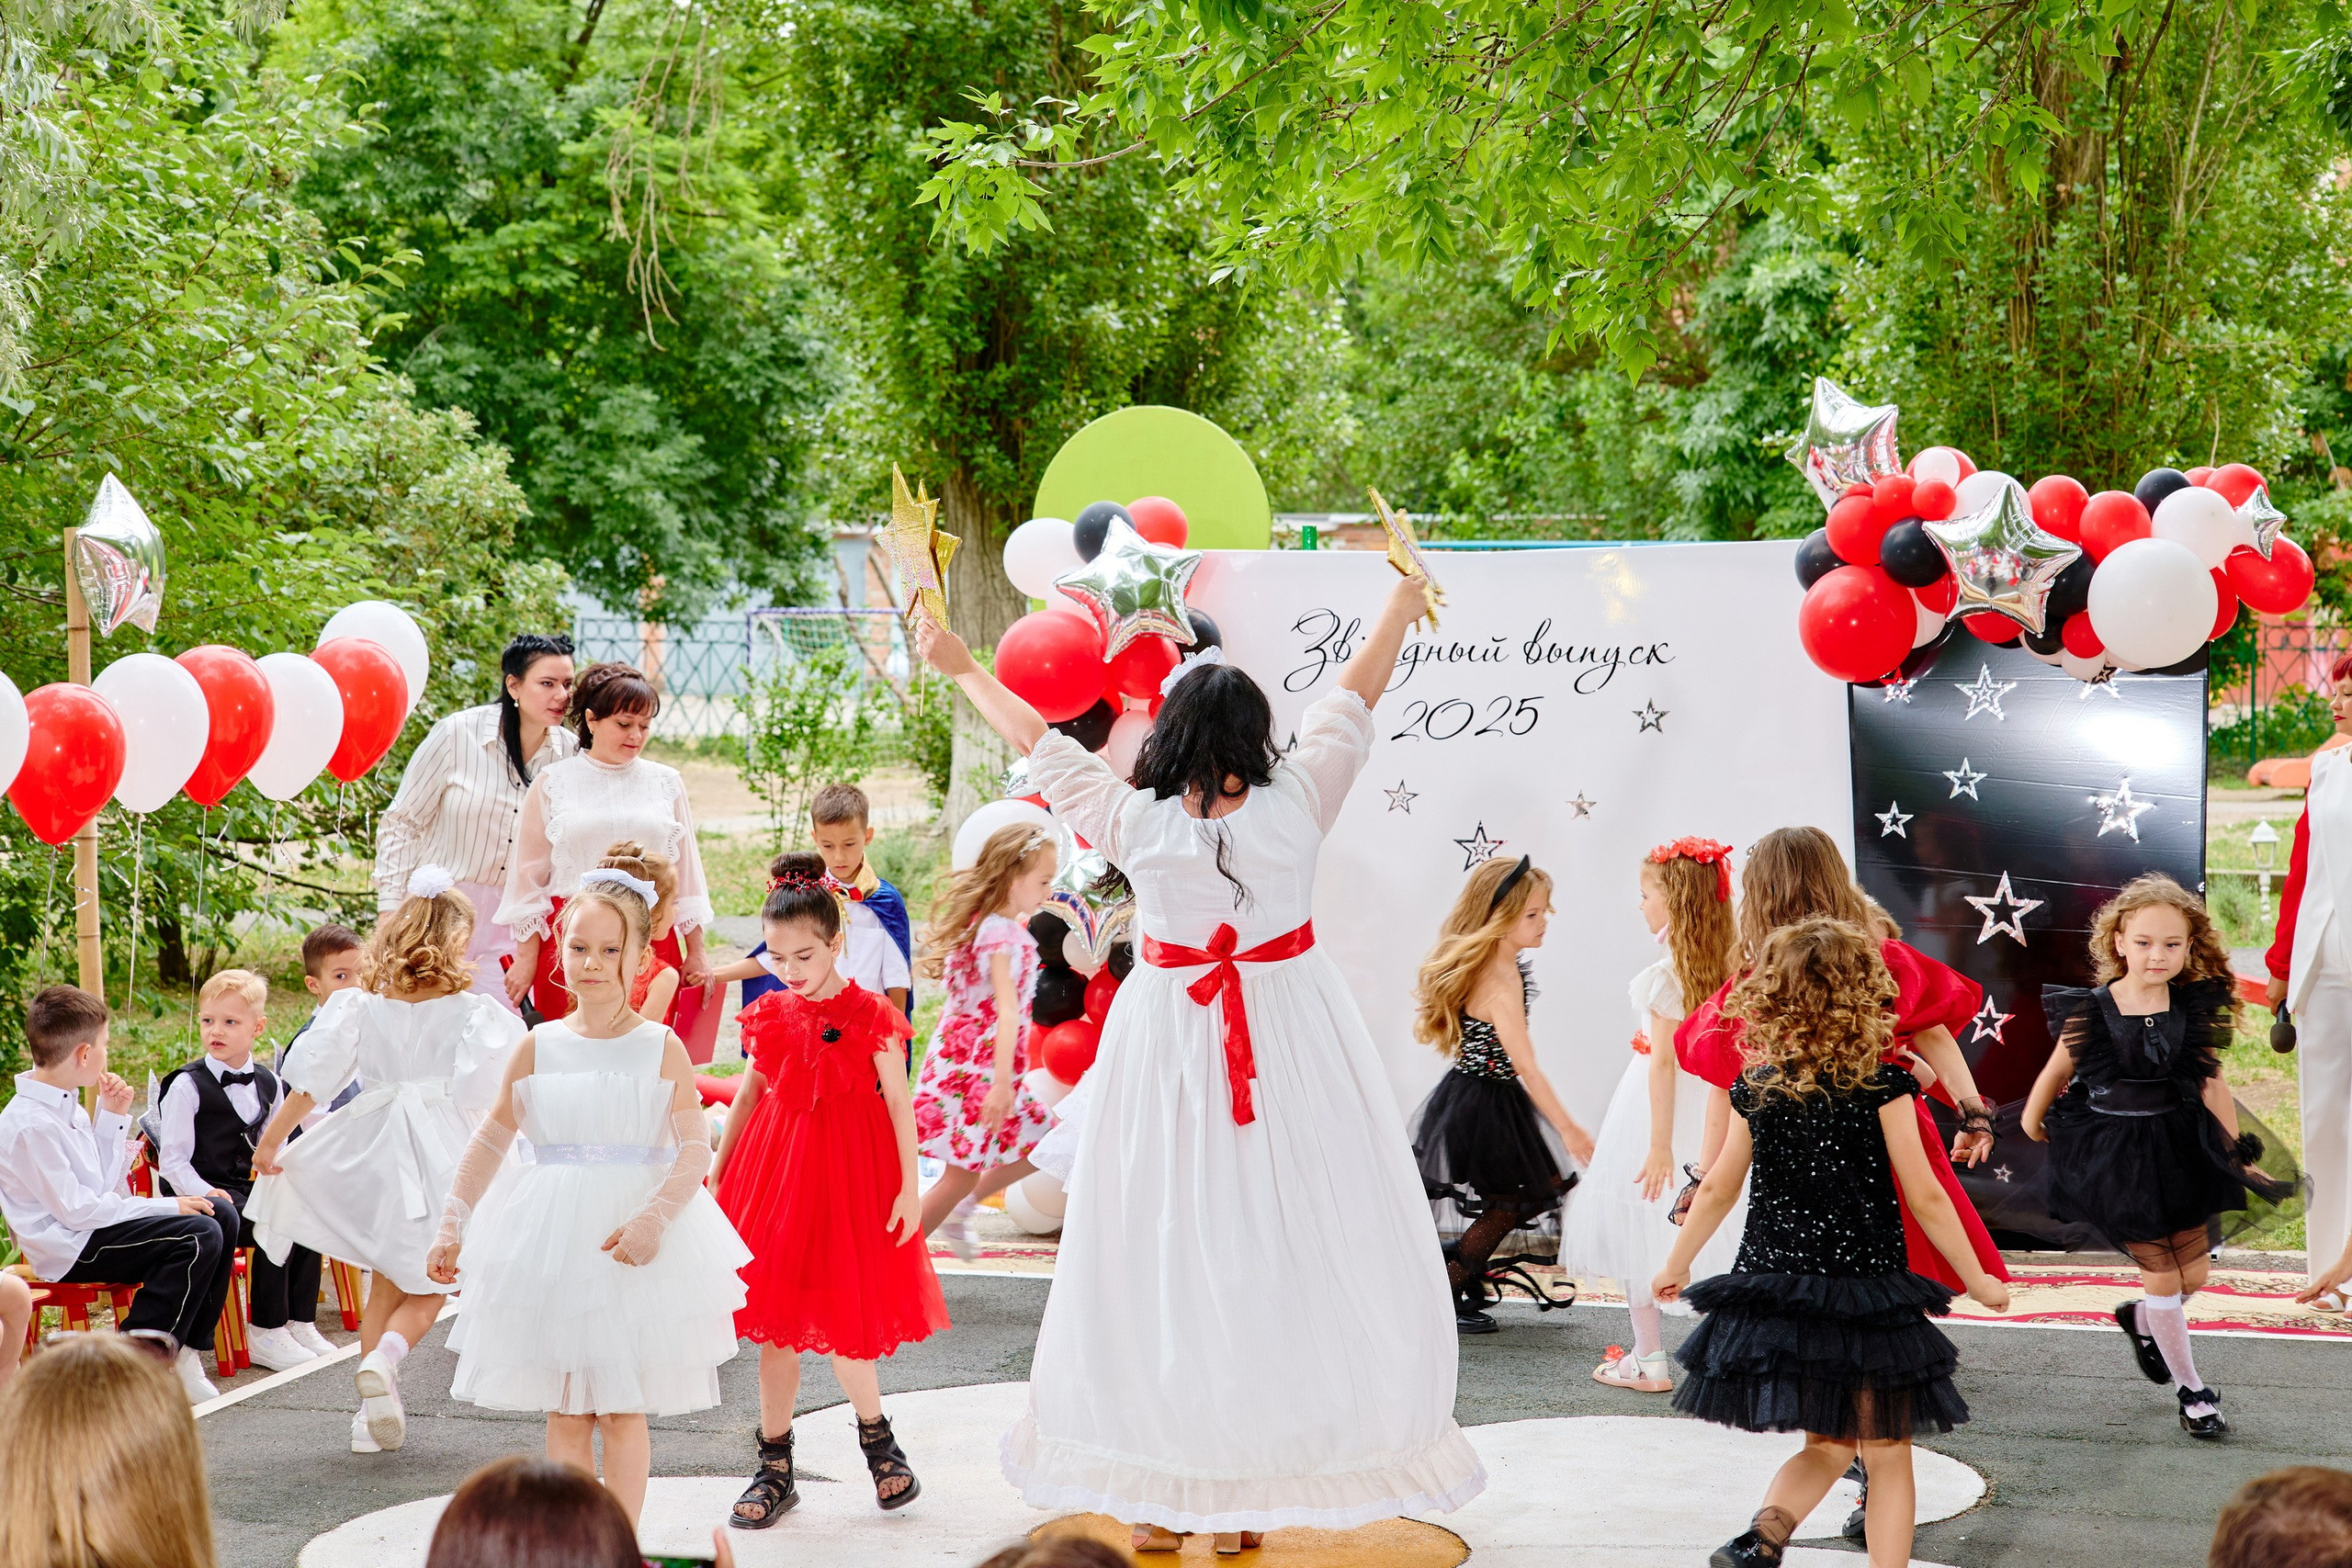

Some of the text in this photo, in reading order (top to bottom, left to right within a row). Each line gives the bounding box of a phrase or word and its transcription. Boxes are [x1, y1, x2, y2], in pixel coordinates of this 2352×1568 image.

[1283, 608, 1676, 694] Звдный выпуск
[1390, 695, 1544, 740] 2025
